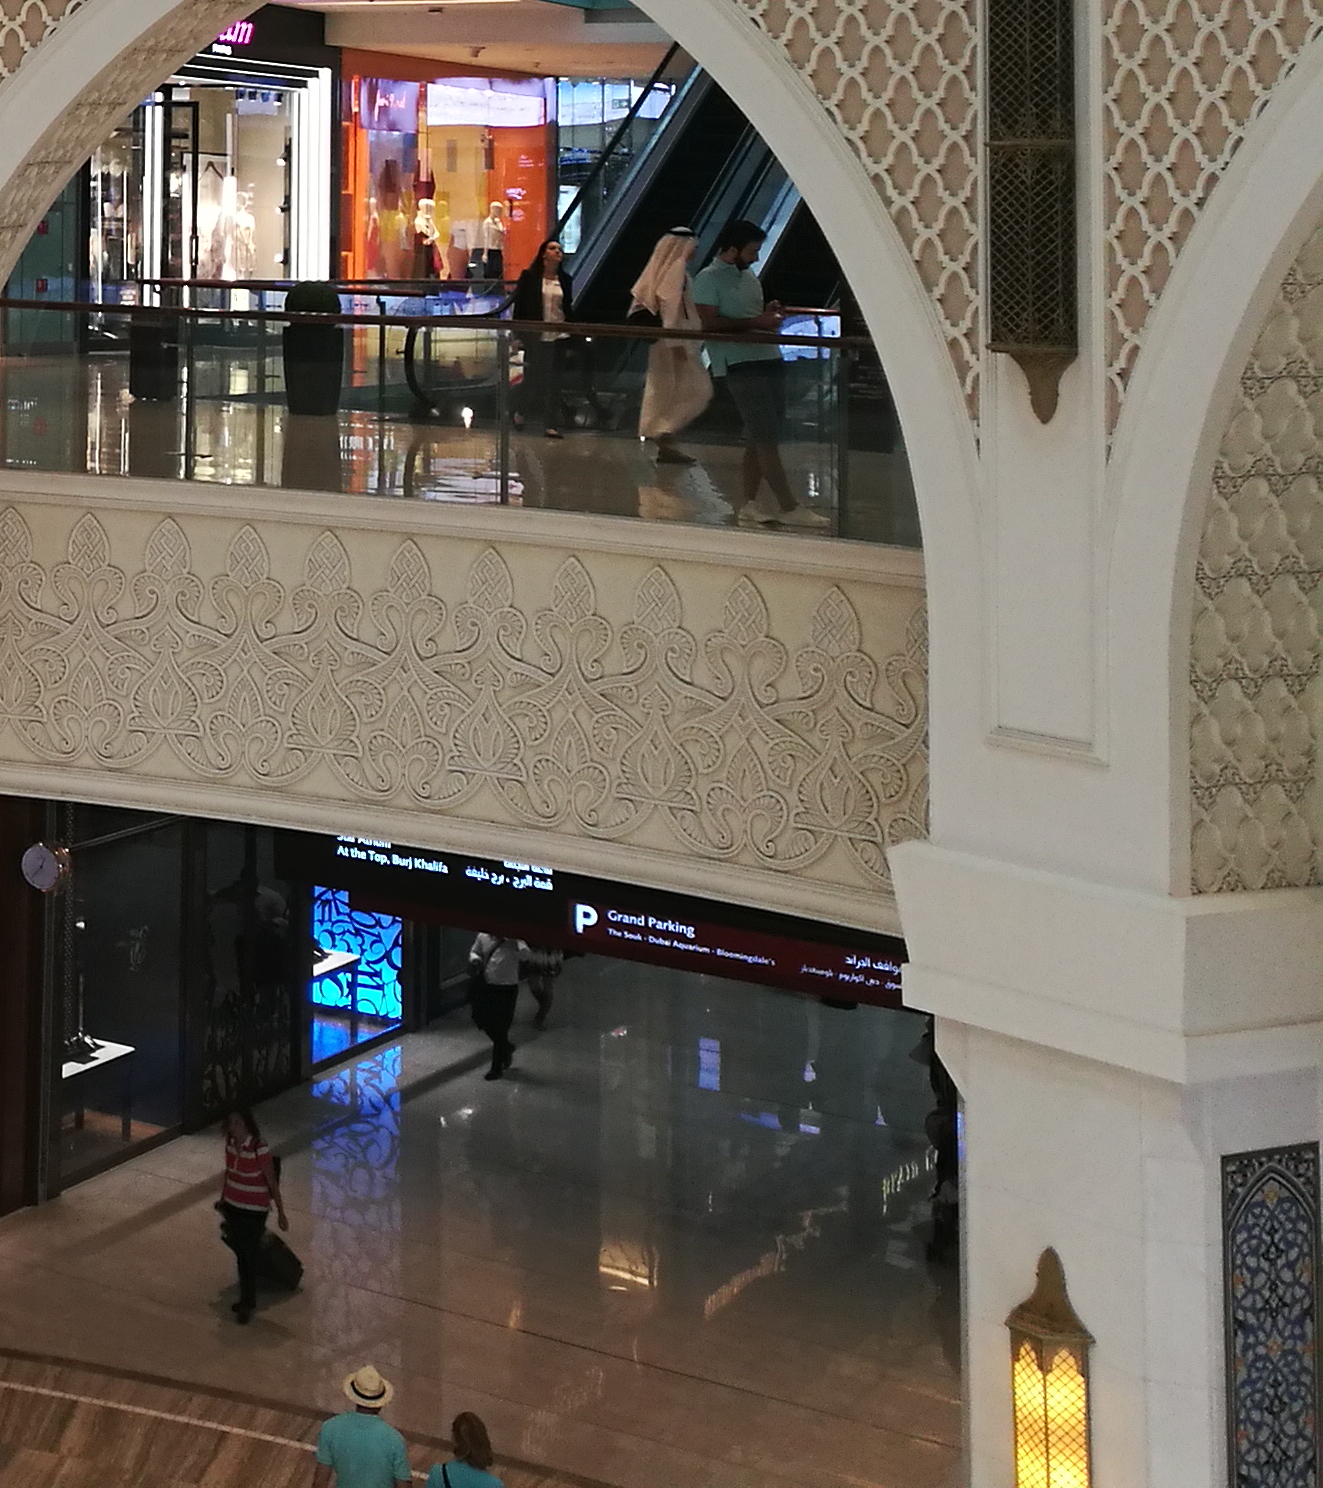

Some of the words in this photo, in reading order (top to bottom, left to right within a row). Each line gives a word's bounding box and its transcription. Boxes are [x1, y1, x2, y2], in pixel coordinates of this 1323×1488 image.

[336, 845, 349, 857] At
[350, 847, 367, 860] the
[392, 854, 413, 870] Burj
[414, 858, 449, 874] Khalifa
[607, 909, 645, 927] Grand
[647, 916, 696, 939] Parking
[608, 928, 622, 937] The
[623, 930, 643, 941] Souk
[648, 935, 672, 947] Dubai
[672, 940, 711, 955] Aquarium
[716, 948, 776, 967] Bloomingdale's
